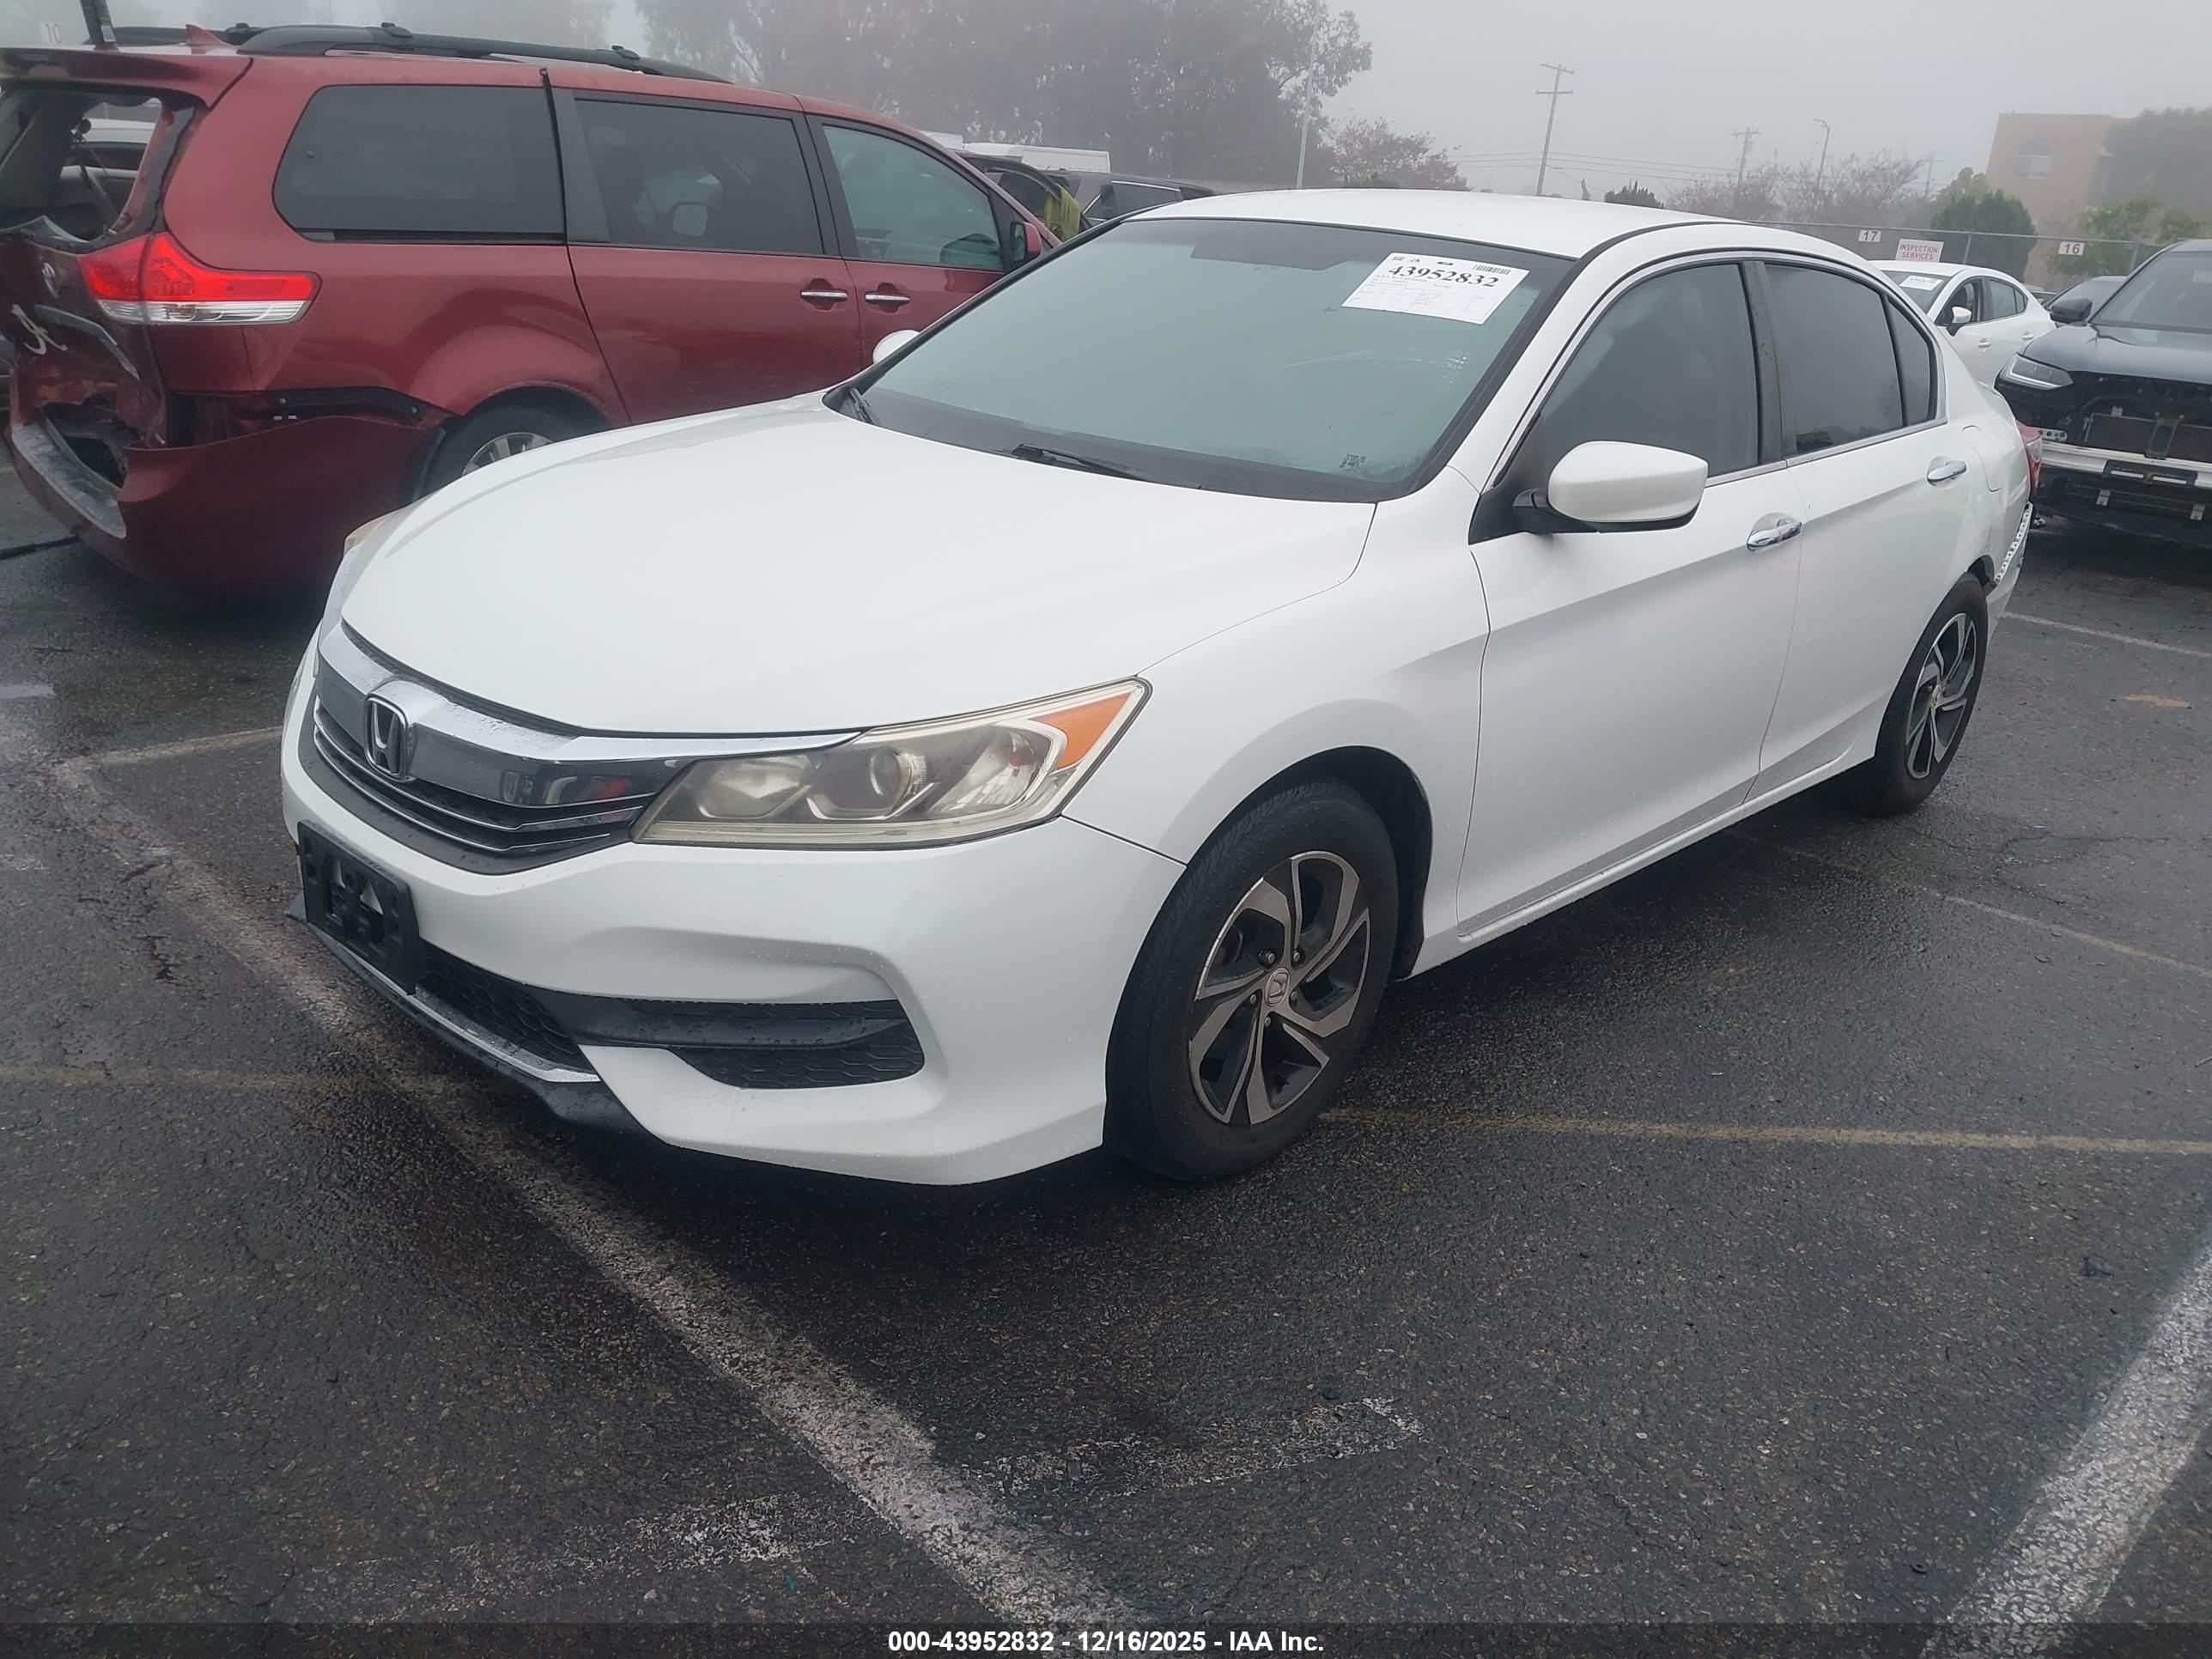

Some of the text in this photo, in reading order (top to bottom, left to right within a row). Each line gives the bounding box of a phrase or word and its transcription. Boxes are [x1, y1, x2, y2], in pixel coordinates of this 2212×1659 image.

[44, 22, 63, 44] 10
[1863, 230, 1878, 241] 17
[1899, 244, 1939, 254] INSPECTION
[2064, 243, 2081, 254] 16
[1902, 252, 1935, 260] SERVICES
[1388, 265, 1500, 288] 43952832
